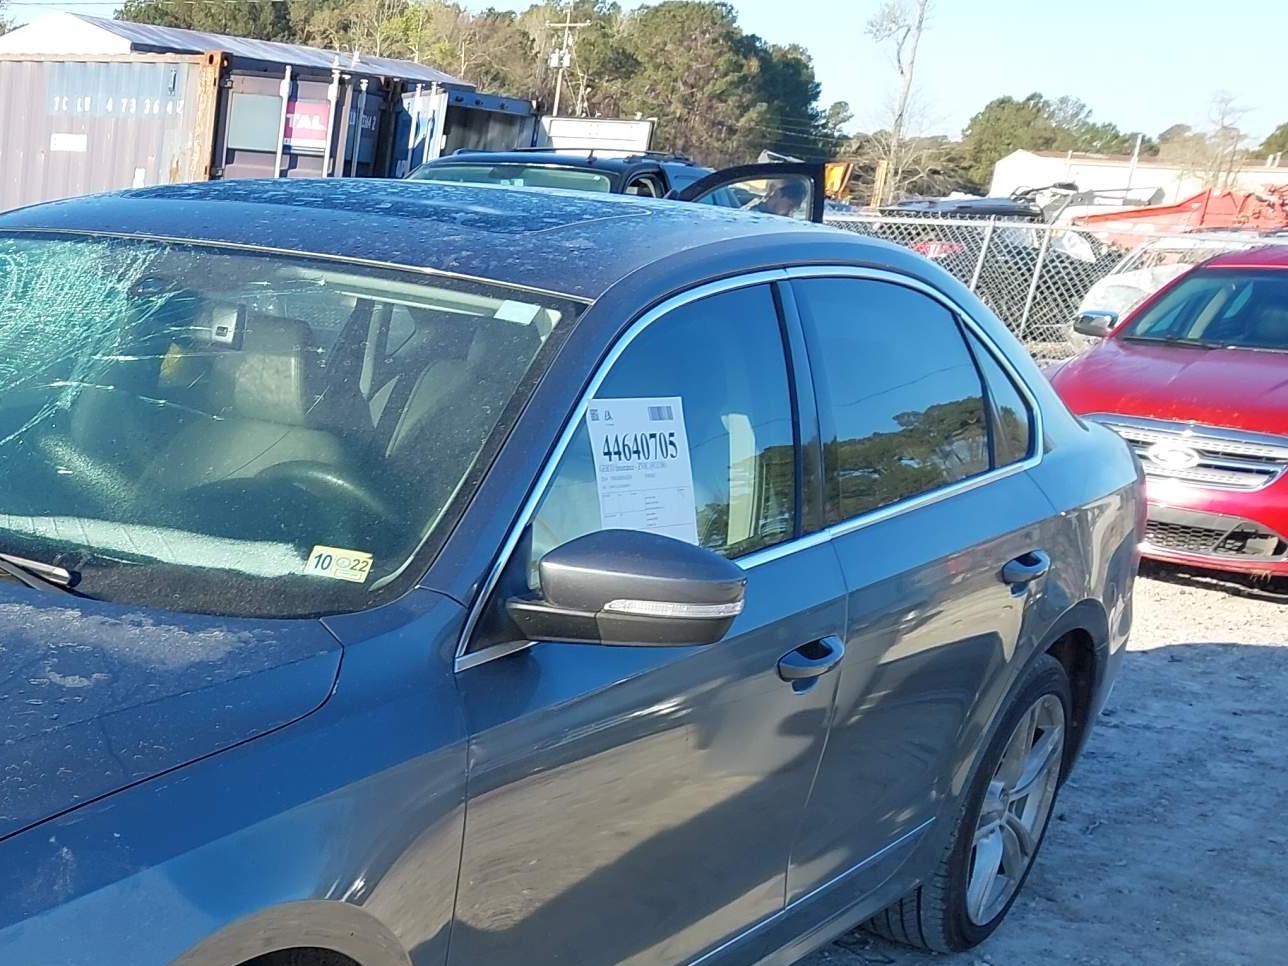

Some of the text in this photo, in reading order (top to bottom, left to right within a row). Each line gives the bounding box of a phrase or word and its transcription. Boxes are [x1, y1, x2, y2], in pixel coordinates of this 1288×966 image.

[603, 432, 678, 462] 44640705
[314, 553, 369, 572] 10 22
